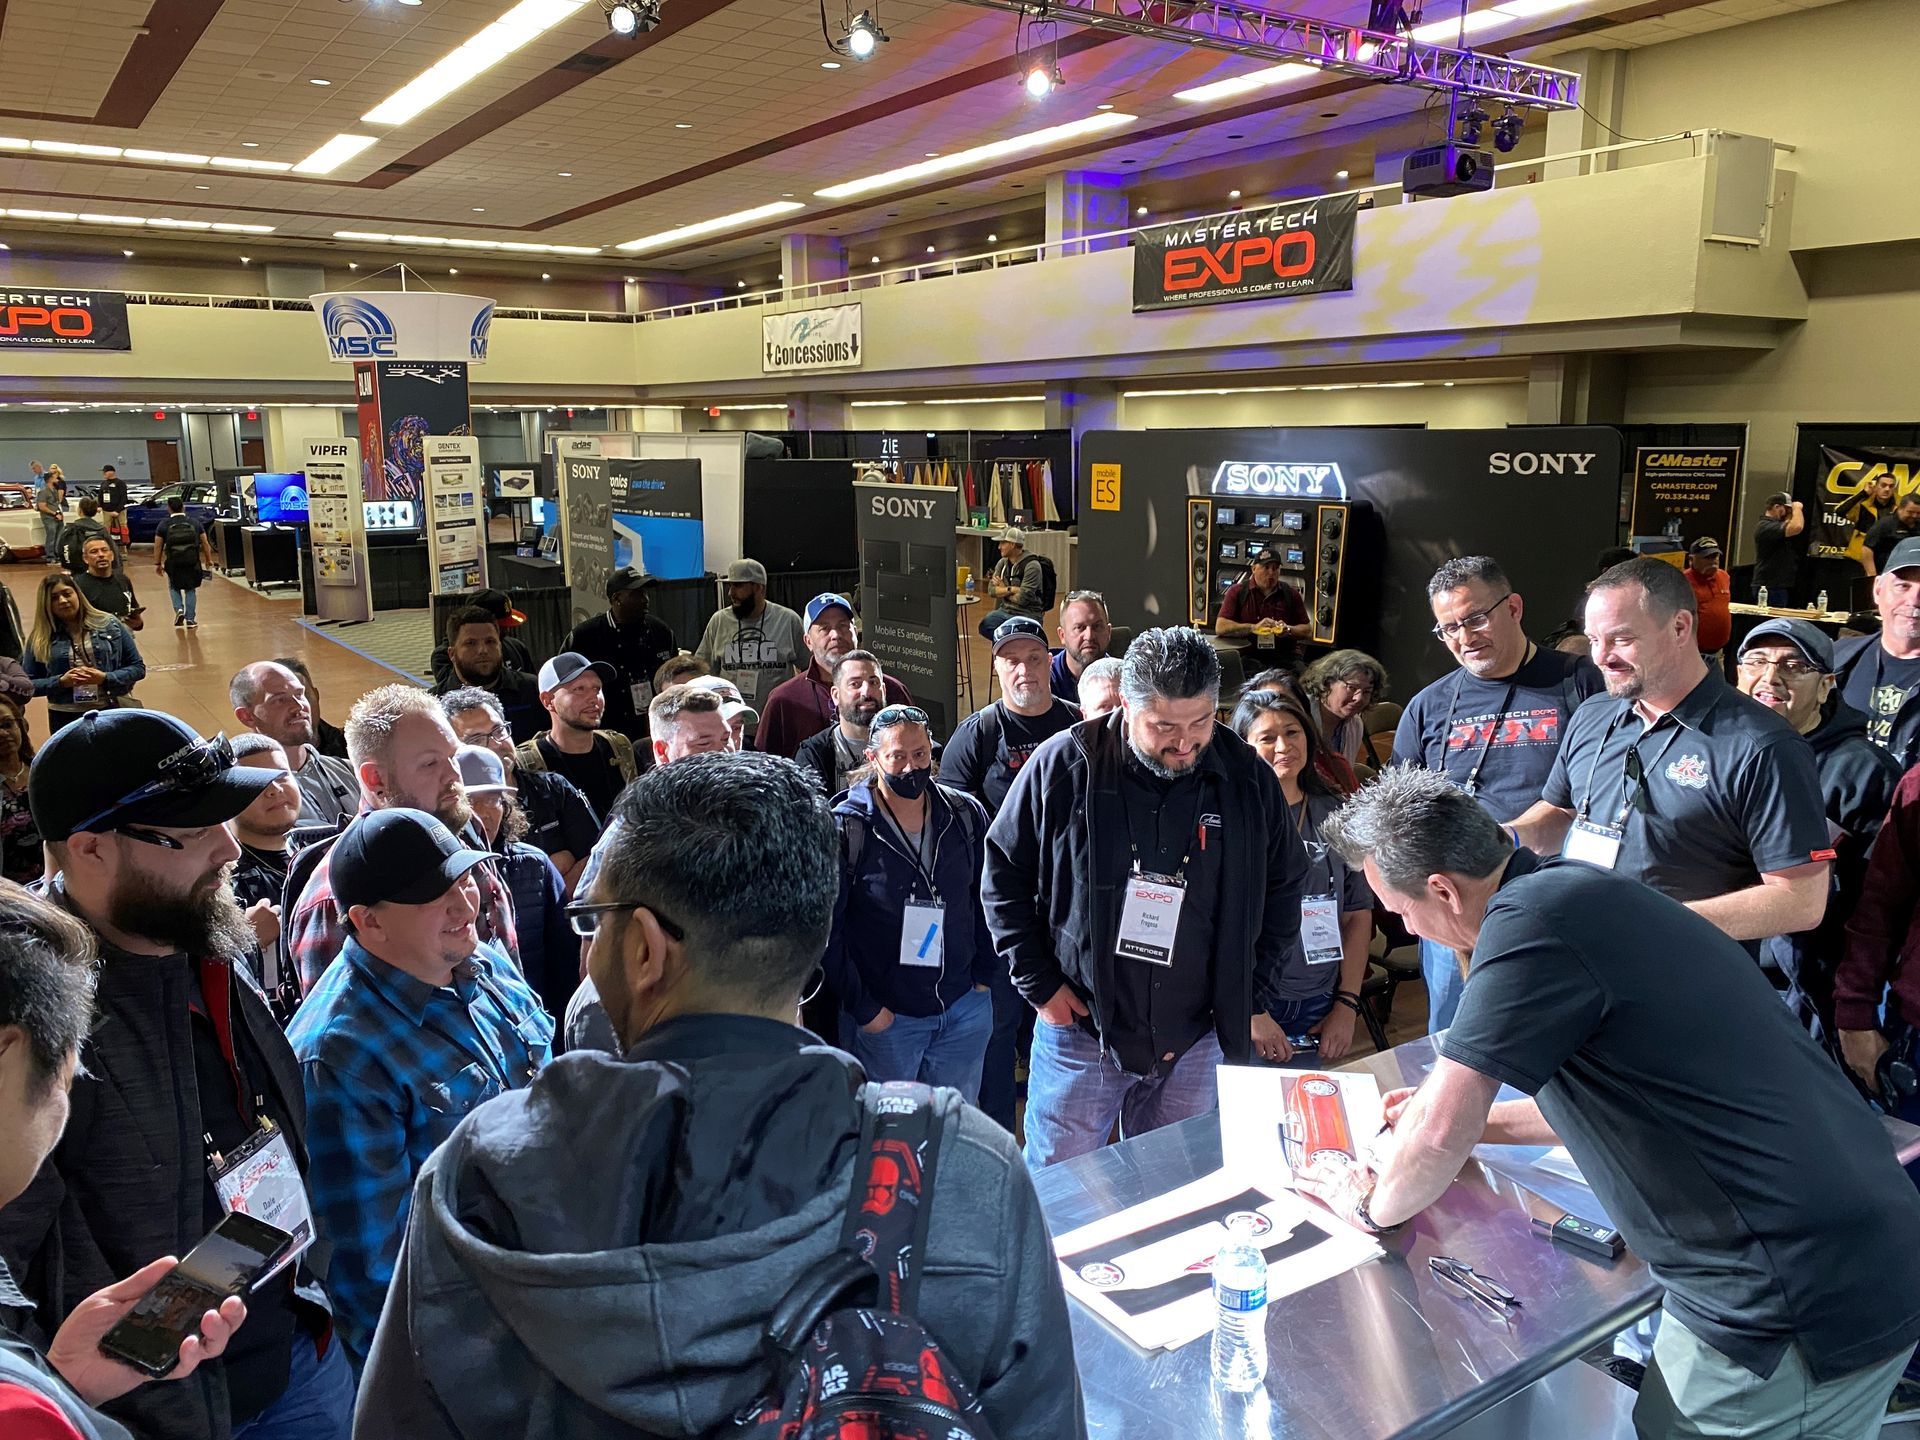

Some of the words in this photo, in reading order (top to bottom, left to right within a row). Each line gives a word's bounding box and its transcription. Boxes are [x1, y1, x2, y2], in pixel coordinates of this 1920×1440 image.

[1163, 231, 1316, 291] EXPO
[1164, 292, 1187, 301] WHERE
[1189, 286, 1248, 299] PROFESSIONALS
[1250, 283, 1272, 291] COME
[1274, 281, 1285, 289] TO
[1287, 278, 1314, 288] LEARN
[329, 336, 397, 358] MSC
[774, 340, 849, 365] Concessions
[310, 445, 348, 456] VIPER
[1488, 452, 1596, 475] SONY
[1645, 453, 1728, 467] CAMaster
[571, 463, 600, 480] SONY
[1097, 469, 1116, 478] mobile
[1226, 464, 1331, 493] SONY
[1097, 479, 1116, 504] ES
[1650, 482, 1718, 490] CAMASTER.COM
[871, 495, 936, 519] SONY
[874, 625, 896, 636] Mobile
[897, 628, 905, 638] ES
[905, 631, 935, 643] amplifiers.
[872, 640, 886, 651] Give
[886, 645, 901, 653] your
[902, 646, 927, 659] speakers
[927, 651, 938, 661] the
[896, 661, 911, 672] they
[1530, 708, 1558, 716] EXPO
[1135, 889, 1173, 904] EXPO
[1142, 911, 1160, 922] Richard
[1125, 943, 1164, 957] ATTENDEE
[262, 1196, 276, 1211] Dale
